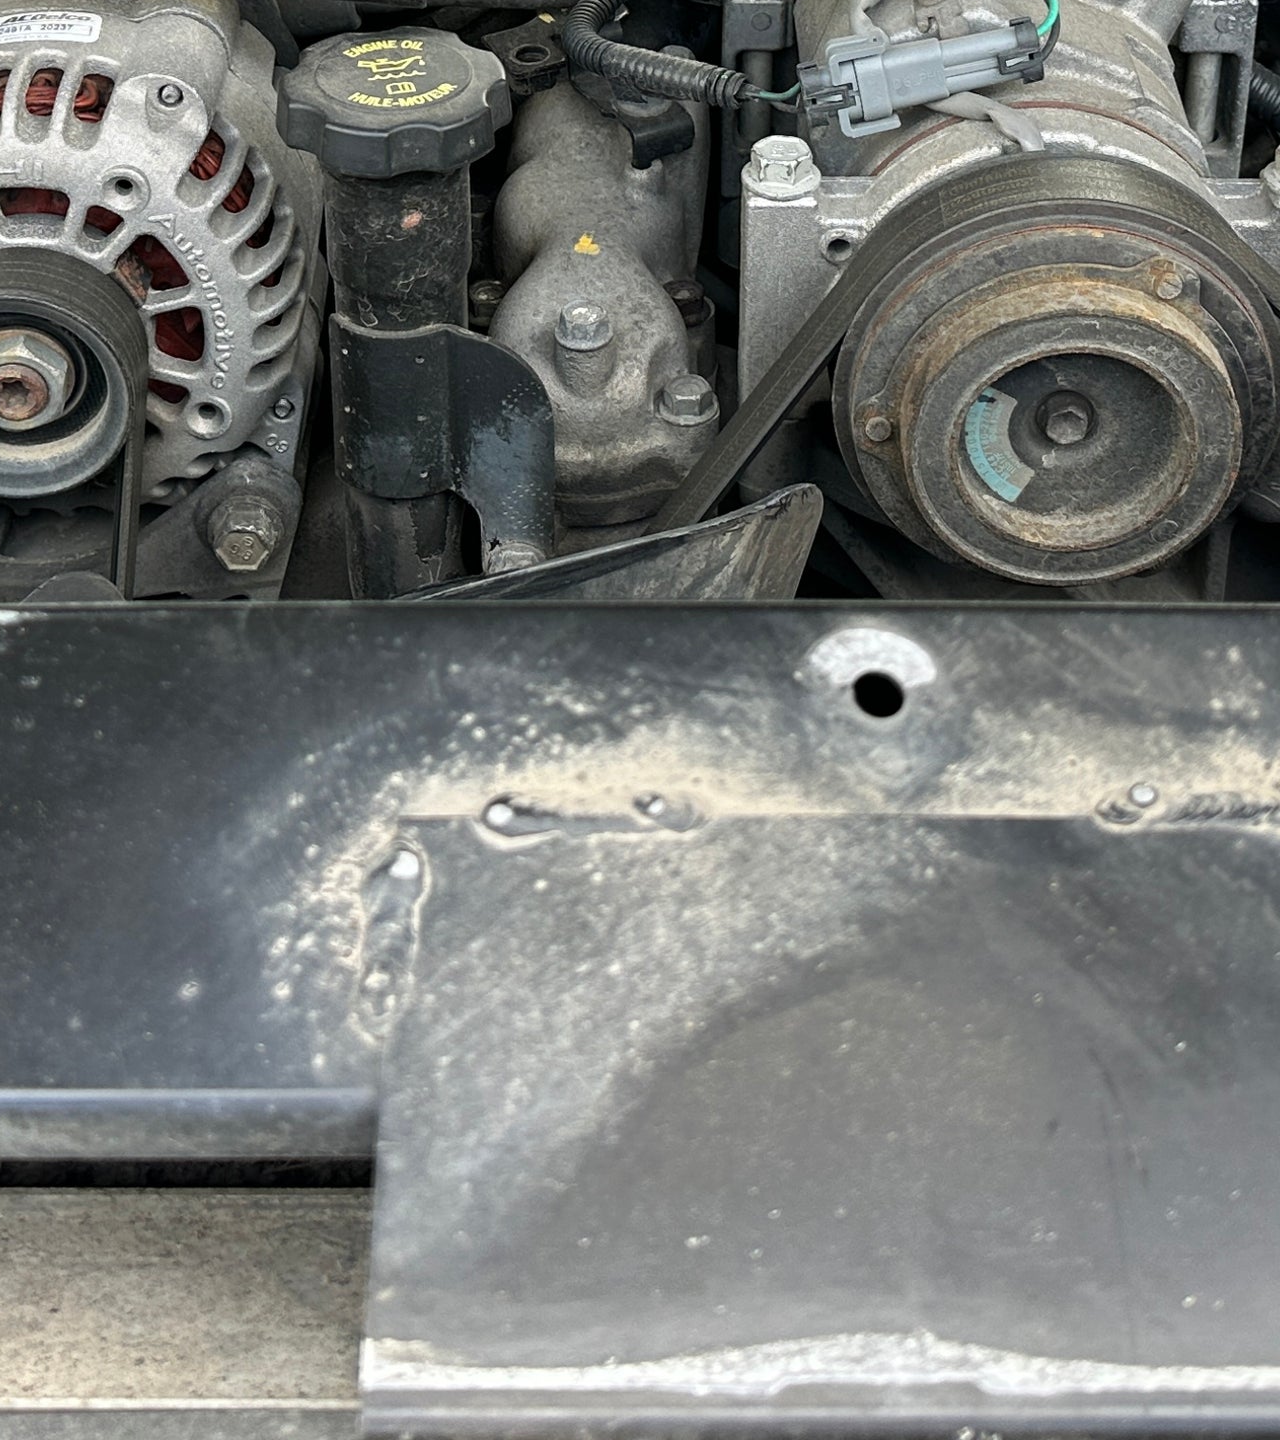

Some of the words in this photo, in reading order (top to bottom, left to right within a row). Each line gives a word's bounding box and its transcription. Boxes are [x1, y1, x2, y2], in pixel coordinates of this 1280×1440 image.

[1, 12, 91, 26] ACDelco
[343, 39, 397, 58] ENGINE
[400, 39, 424, 51] OIL
[347, 82, 458, 108] HUILE-MOTEUR
[146, 211, 236, 391] Automotive
